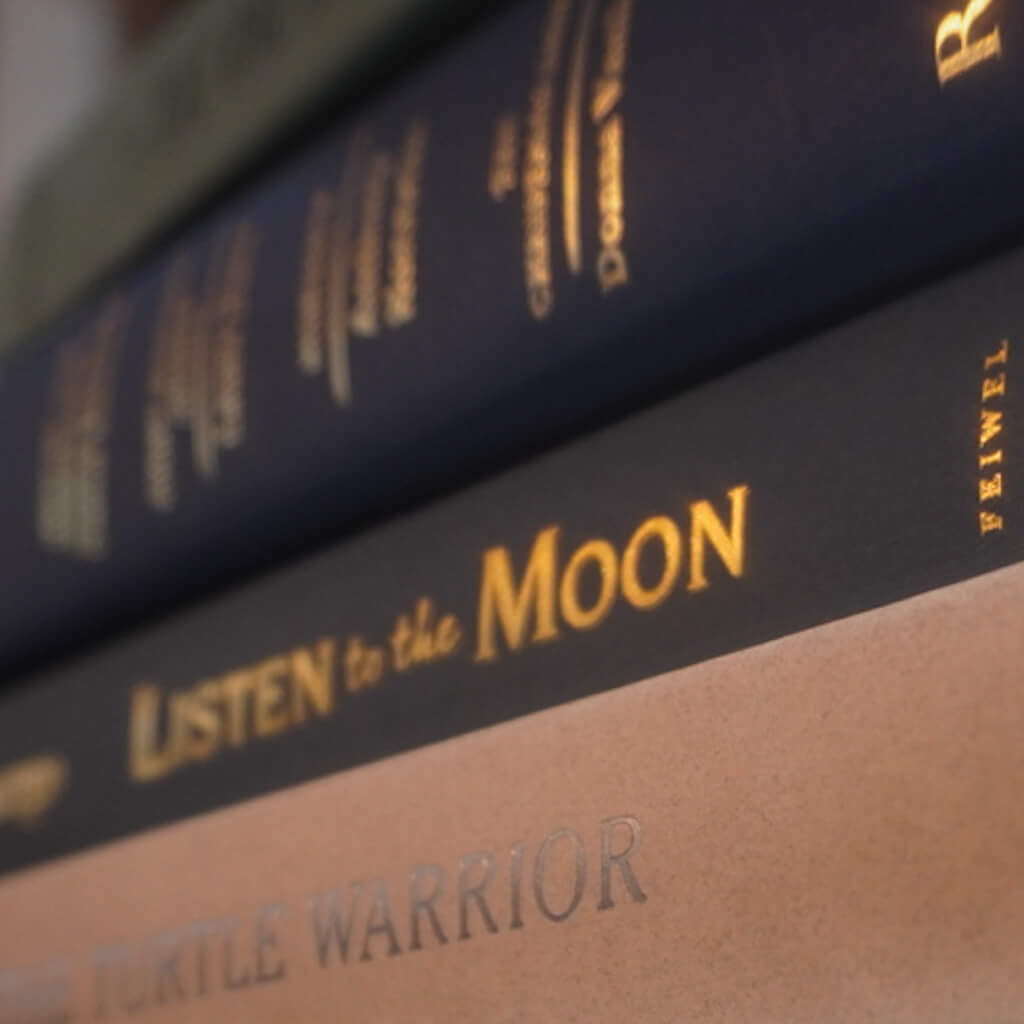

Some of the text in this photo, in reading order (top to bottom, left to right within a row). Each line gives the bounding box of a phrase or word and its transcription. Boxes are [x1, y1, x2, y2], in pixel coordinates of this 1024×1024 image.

[978, 338, 1010, 536] FEIWEL
[129, 485, 749, 783] LISTEN to the MOON
[309, 814, 648, 970] WARRIOR
